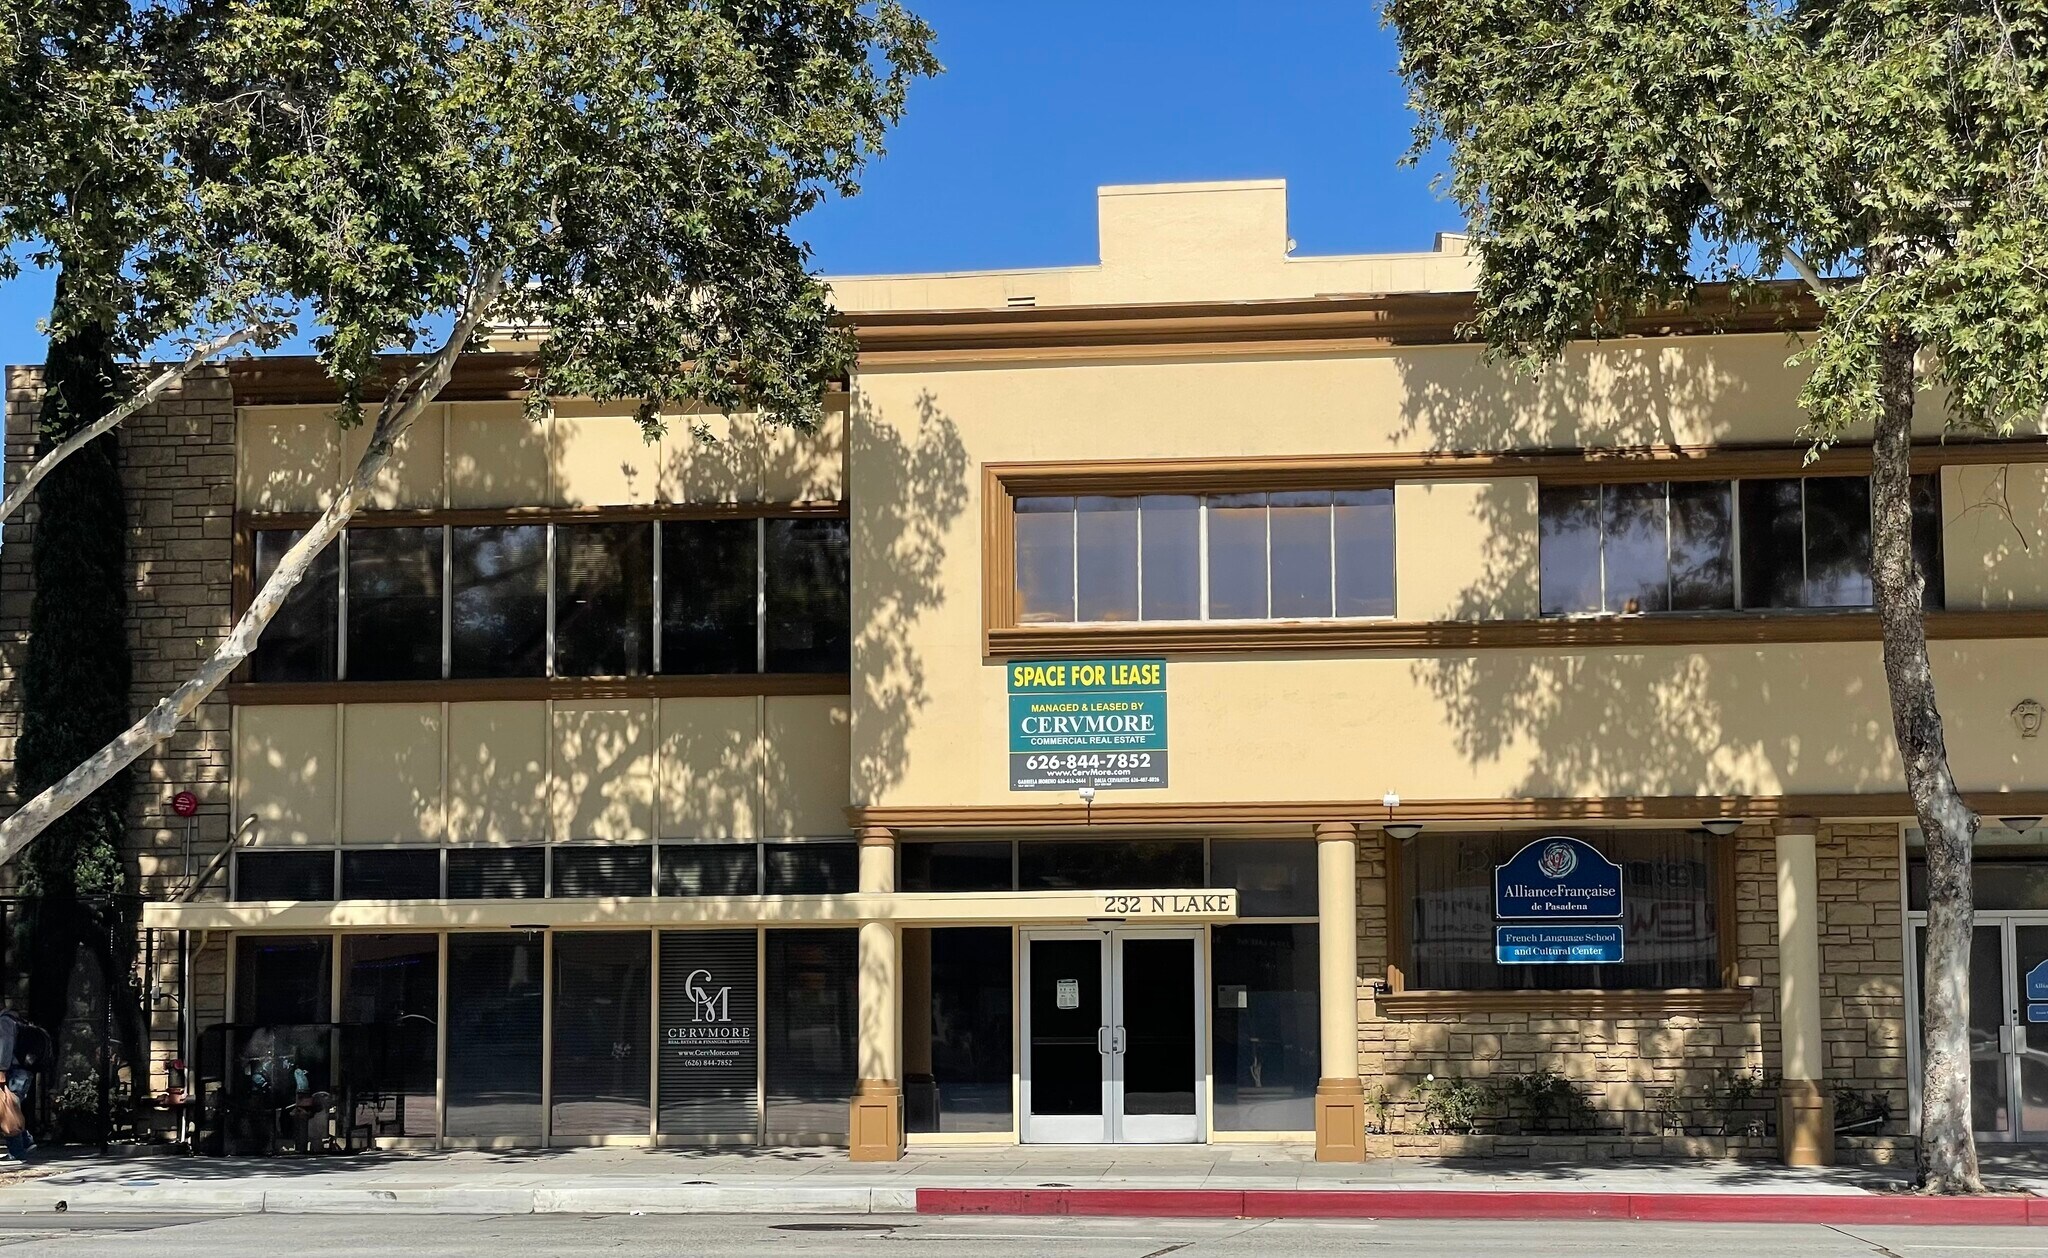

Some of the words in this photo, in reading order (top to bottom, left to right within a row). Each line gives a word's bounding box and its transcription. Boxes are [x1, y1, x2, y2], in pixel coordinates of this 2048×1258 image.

[1013, 665, 1066, 687] SPACE
[1071, 665, 1106, 686] FOR
[1111, 664, 1161, 685] LEASE
[1031, 704, 1079, 712] MANAGED
[1091, 703, 1128, 711] LEASED
[1131, 702, 1144, 710] BY
[1021, 714, 1155, 734] CERVMORE
[1030, 736, 1088, 745] COMMERCIAL
[1090, 736, 1112, 744] REAL
[1114, 735, 1146, 744] ESTATE
[1026, 753, 1151, 770] 626-844-7852
[1046, 769, 1131, 777] www.CervMore.com
[1504, 884, 1616, 899] AllianceFrançaise
[1104, 896, 1141, 914] 232
[1151, 896, 1166, 913] N
[1172, 895, 1230, 912] LAKE
[1531, 902, 1542, 911] de
[1545, 902, 1588, 911] Pasadena
[1506, 934, 1538, 943] French
[1540, 934, 1584, 943] Language
[1585, 933, 1616, 941] School
[1514, 946, 1531, 955] and
[1532, 946, 1571, 955] Cultural
[1572, 946, 1603, 955] Center
[668, 1027, 751, 1038] CERVMORE
[684, 1059, 702, 1067] (626)
